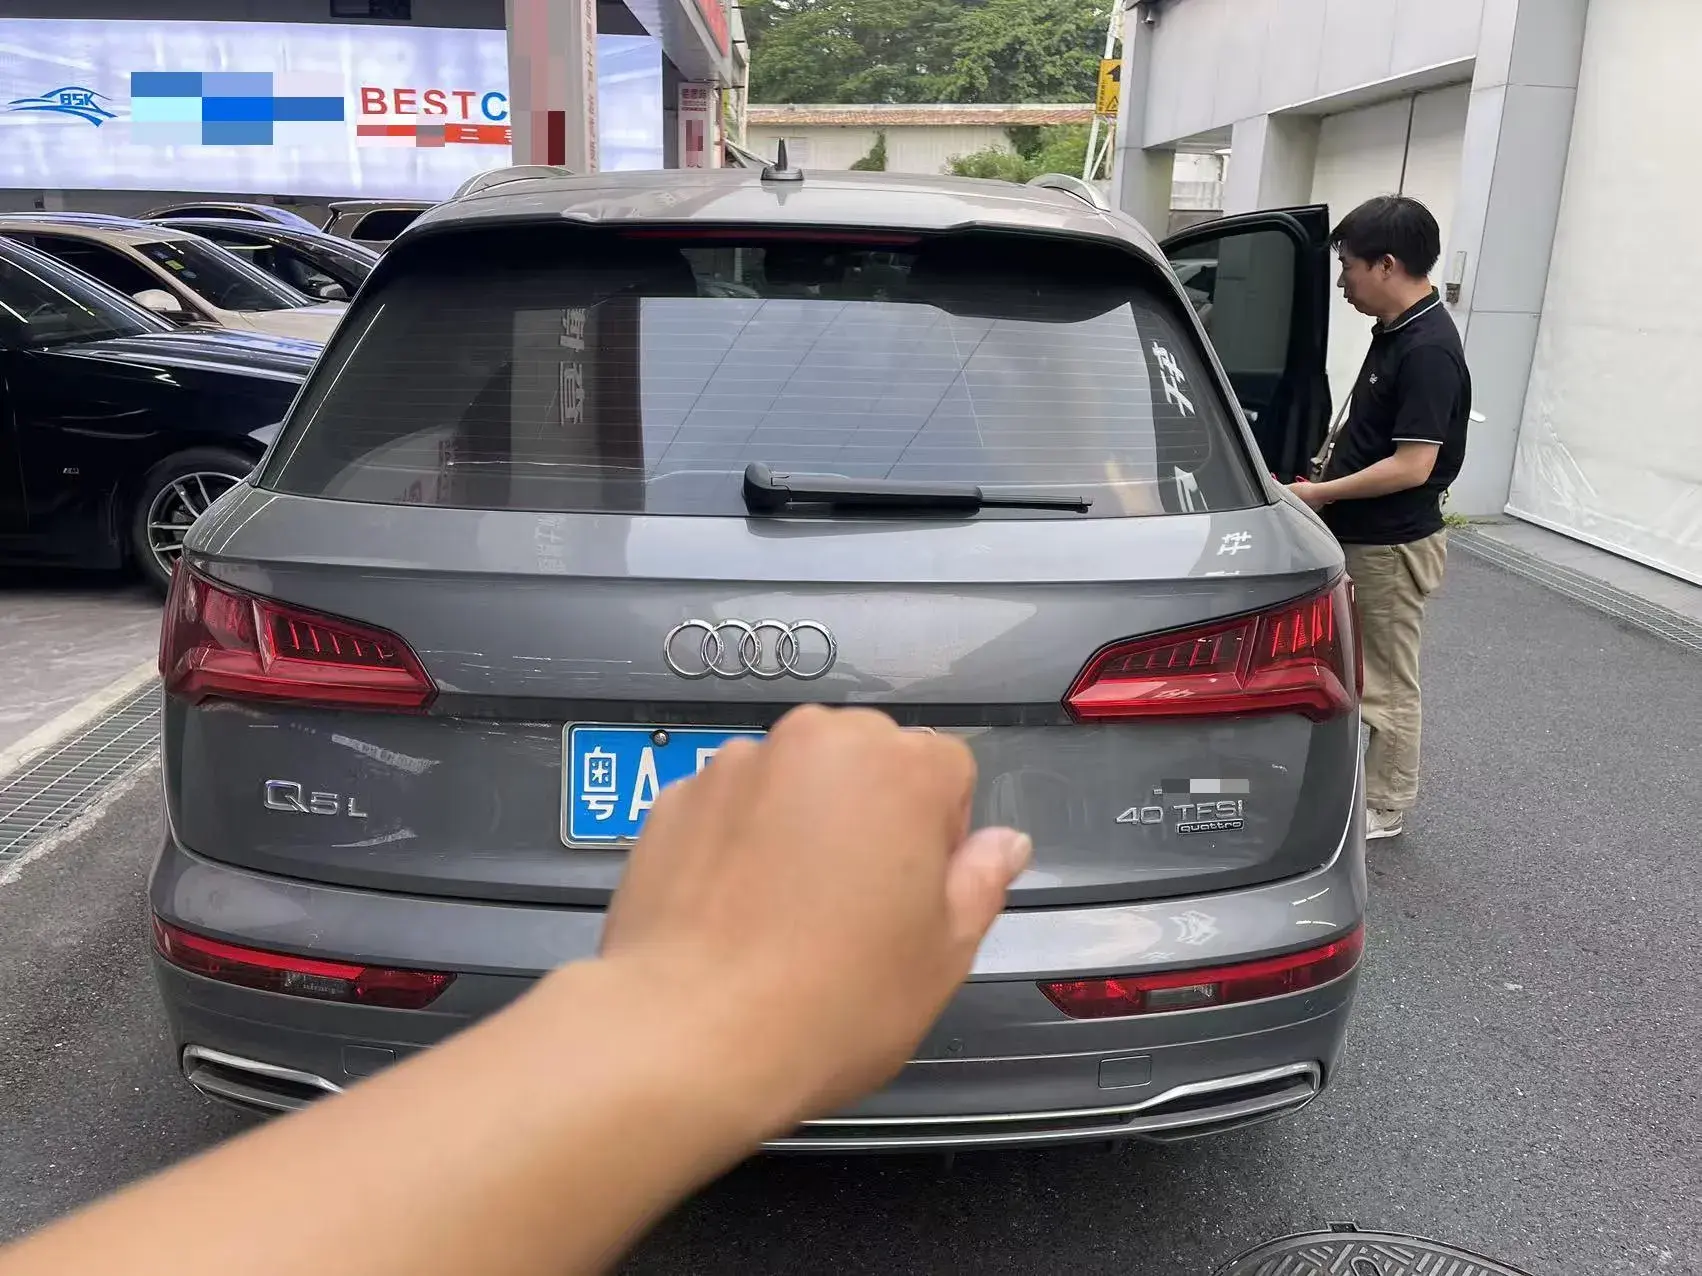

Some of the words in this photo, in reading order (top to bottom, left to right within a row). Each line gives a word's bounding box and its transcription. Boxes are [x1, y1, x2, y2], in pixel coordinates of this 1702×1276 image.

[361, 87, 508, 121] BESTC
[1115, 806, 1163, 825] 40
[1173, 800, 1244, 820] TFSI
[1180, 821, 1242, 833] quattro
